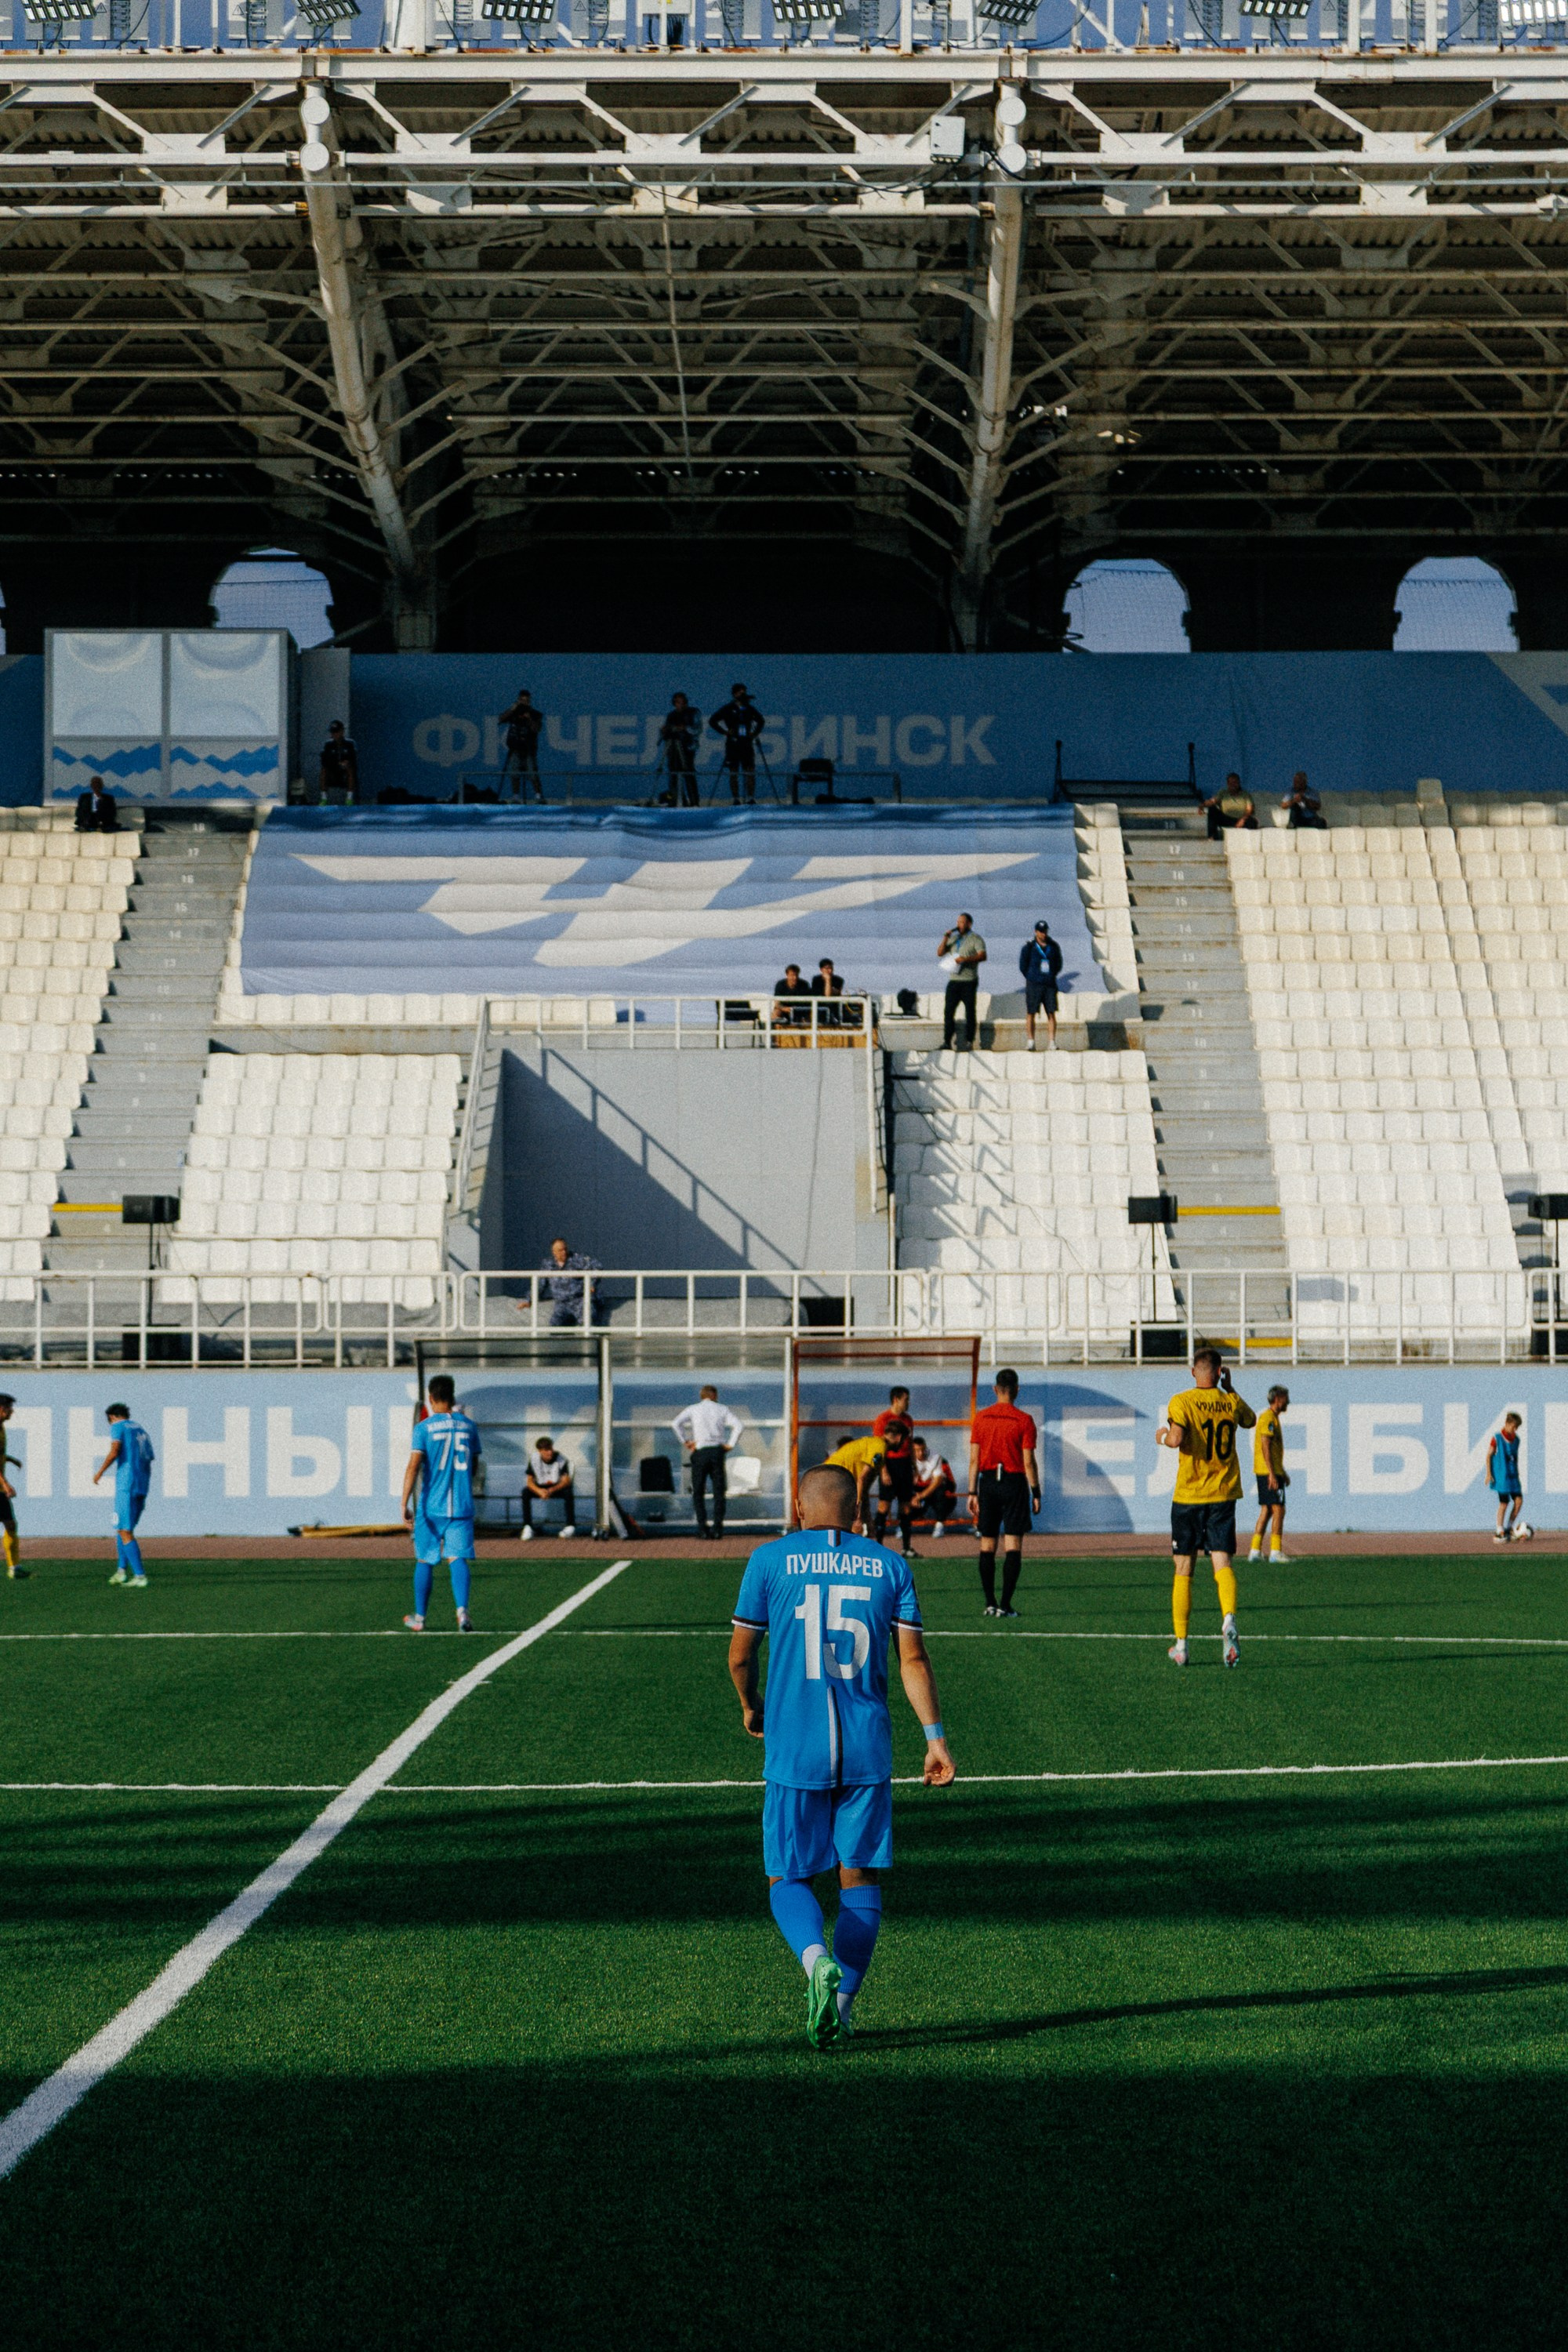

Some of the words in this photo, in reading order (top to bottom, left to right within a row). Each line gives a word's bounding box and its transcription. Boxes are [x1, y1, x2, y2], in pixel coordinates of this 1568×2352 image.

[188, 848, 200, 857] 17
[181, 874, 194, 884] 16
[175, 902, 187, 912] 15
[1176, 897, 1188, 906] 15
[1178, 924, 1192, 934] 14
[5, 1383, 474, 1497] ЬНЫ
[1202, 1418, 1234, 1461] 10
[433, 1432, 470, 1471] 75
[786, 1552, 884, 1578] ПУШКАРЕВ
[795, 1584, 872, 1679] 15
